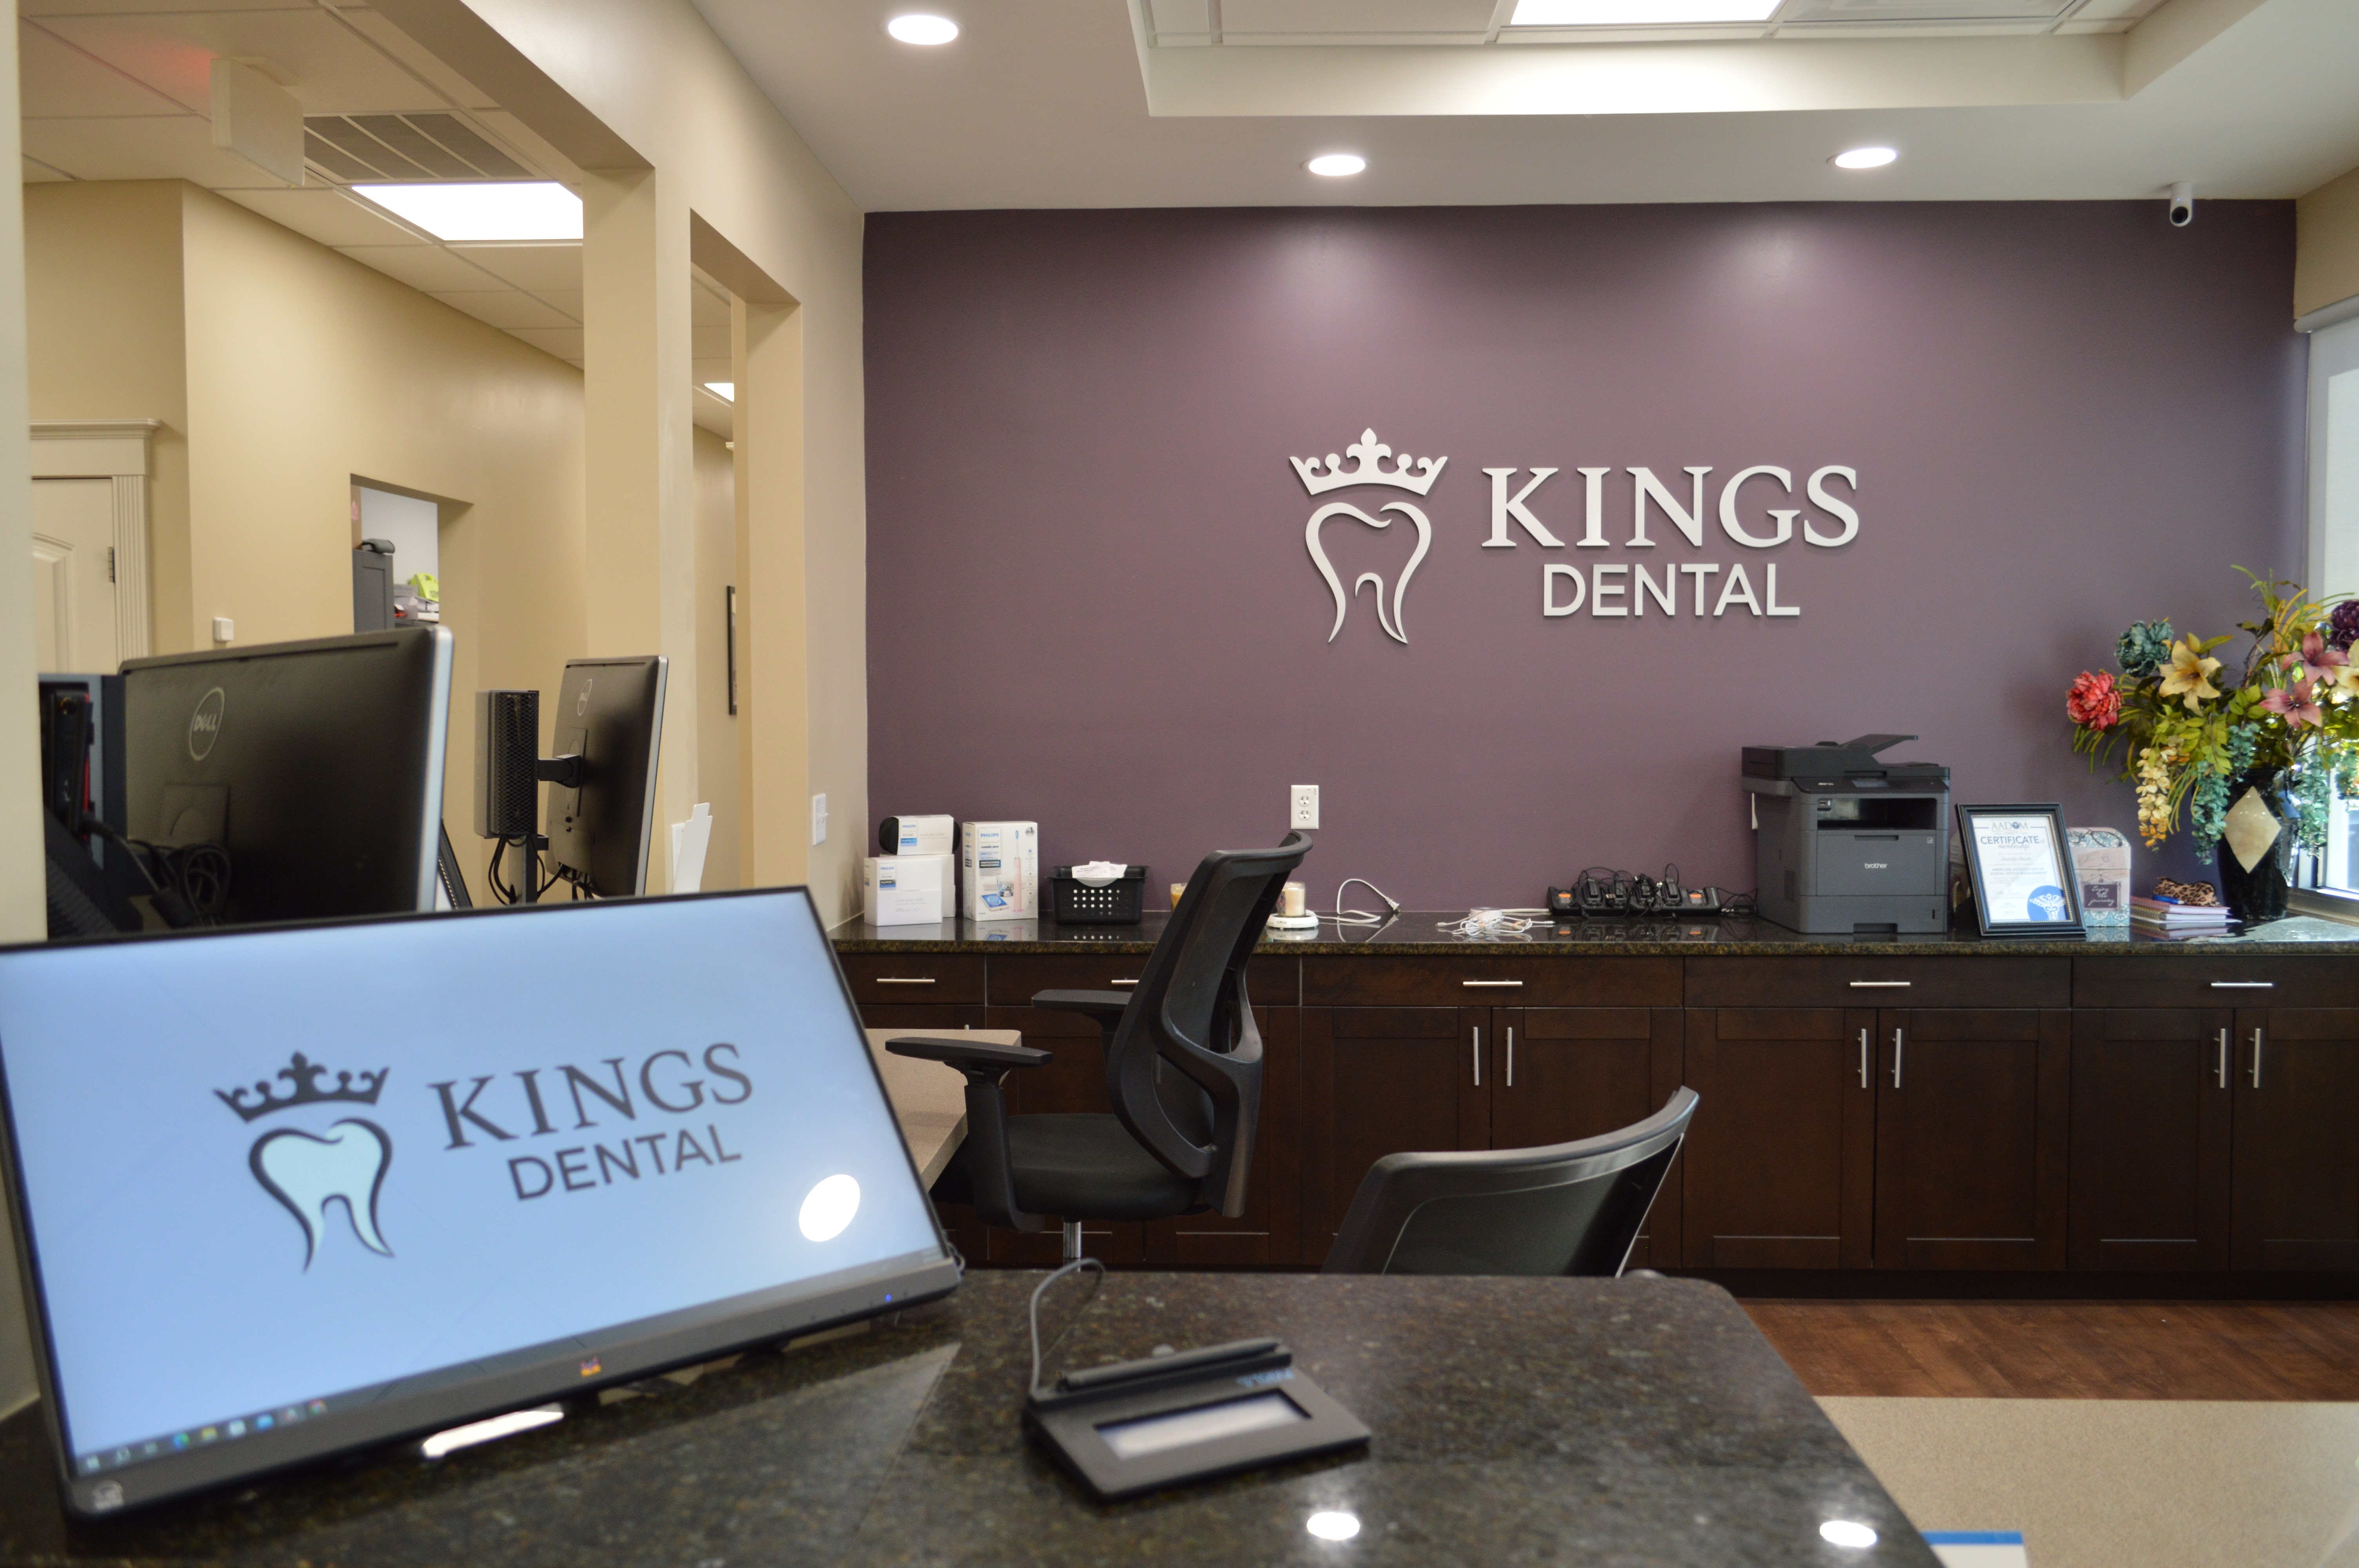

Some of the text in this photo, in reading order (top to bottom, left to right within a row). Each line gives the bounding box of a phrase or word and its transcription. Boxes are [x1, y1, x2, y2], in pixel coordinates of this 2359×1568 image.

[1482, 465, 1859, 547] KINGS
[1543, 563, 1800, 616] DENTAL
[193, 713, 217, 732] DELL
[1981, 836, 2039, 844] CERTIFICATE
[2088, 898, 2114, 907] journey
[2092, 885, 2109, 893] Enjoy
[426, 1042, 753, 1152] KINGS
[507, 1124, 742, 1201] DENTAL
